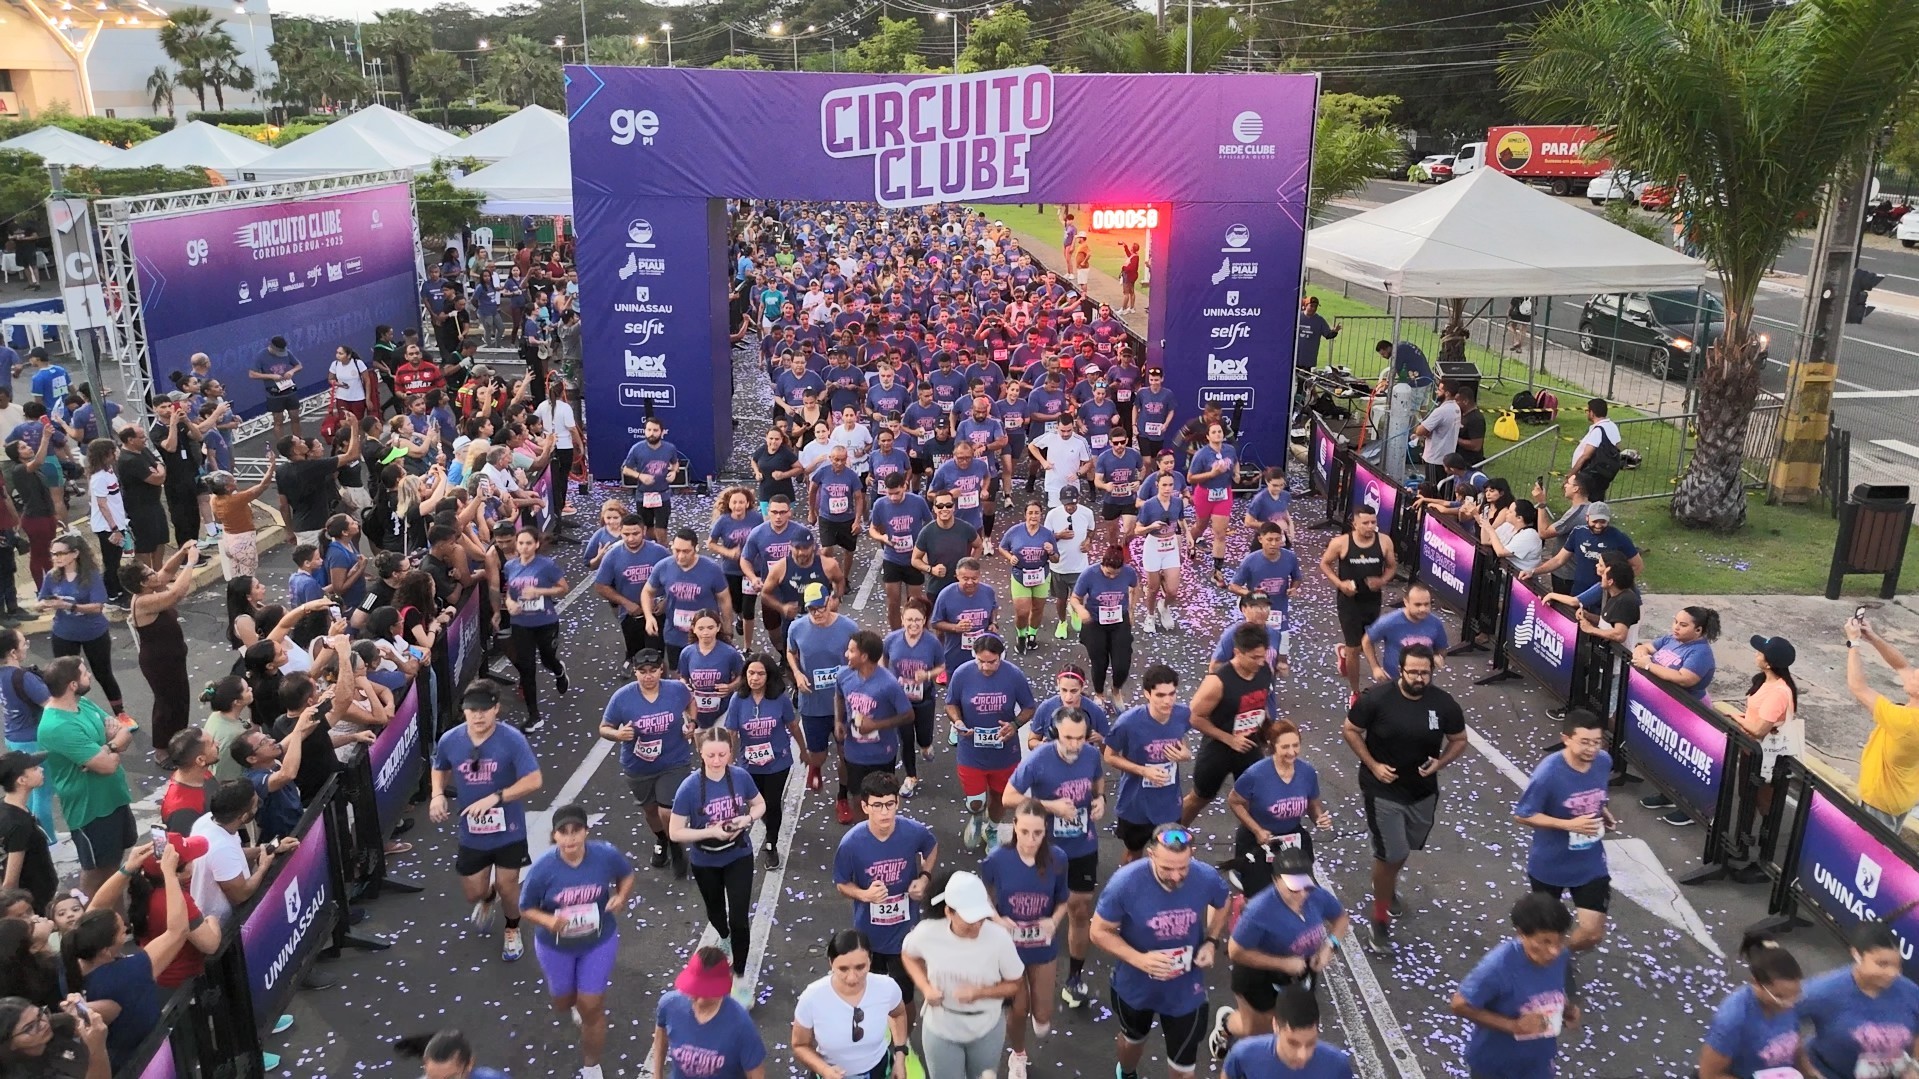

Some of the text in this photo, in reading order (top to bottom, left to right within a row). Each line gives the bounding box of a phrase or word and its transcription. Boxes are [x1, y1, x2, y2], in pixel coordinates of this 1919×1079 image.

[826, 72, 1050, 153] CIRCUITO
[610, 109, 659, 145] ge
[643, 137, 653, 145] PI
[1219, 145, 1275, 154] REDE CLUBE
[880, 134, 1026, 201] CLUBE
[250, 209, 342, 249] CIRCUITO CLUBE
[186, 239, 208, 266] ge
[253, 246, 291, 260] CORRIDA
[293, 244, 303, 254] DE
[305, 241, 320, 251] RUA
[326, 236, 343, 248] 2025
[65, 252, 93, 280] C
[614, 303, 672, 313] UNINASSAU
[1203, 308, 1260, 317] UNINASSAU
[624, 318, 664, 346] selfit
[1210, 322, 1251, 350] selfit
[625, 350, 666, 371] bex
[1208, 354, 1248, 374] bex
[624, 388, 669, 399] Unimed
[1204, 392, 1248, 402] Unimed
[626, 565, 653, 577] CIRCUITO
[1432, 562, 1464, 594] DA GENTE
[691, 671, 721, 681] CIRCUITO
[696, 679, 716, 687] CLUBE
[702, 697, 712, 705] 56
[973, 695, 1007, 705] CIRCUITO
[978, 703, 1003, 712] CLUBE
[638, 713, 674, 729] CIRCUITO
[745, 719, 777, 730] CIRCUITO
[645, 723, 669, 735] CLUBE
[751, 727, 772, 736] CLUBE
[1636, 703, 1713, 776] CIRCUITO CLUBE
[748, 750, 769, 760] 2364
[1637, 721, 1664, 749] CORRIDA
[1664, 745, 1673, 756] DE
[1674, 751, 1687, 768] RUA
[1692, 766, 1711, 785] 2025
[868, 861, 907, 875] CIRCUITO
[875, 871, 901, 882] CLUBE
[878, 903, 899, 914] 324
[1814, 863, 1914, 961] UNINASU
[264, 884, 326, 991] UNINASSAU
